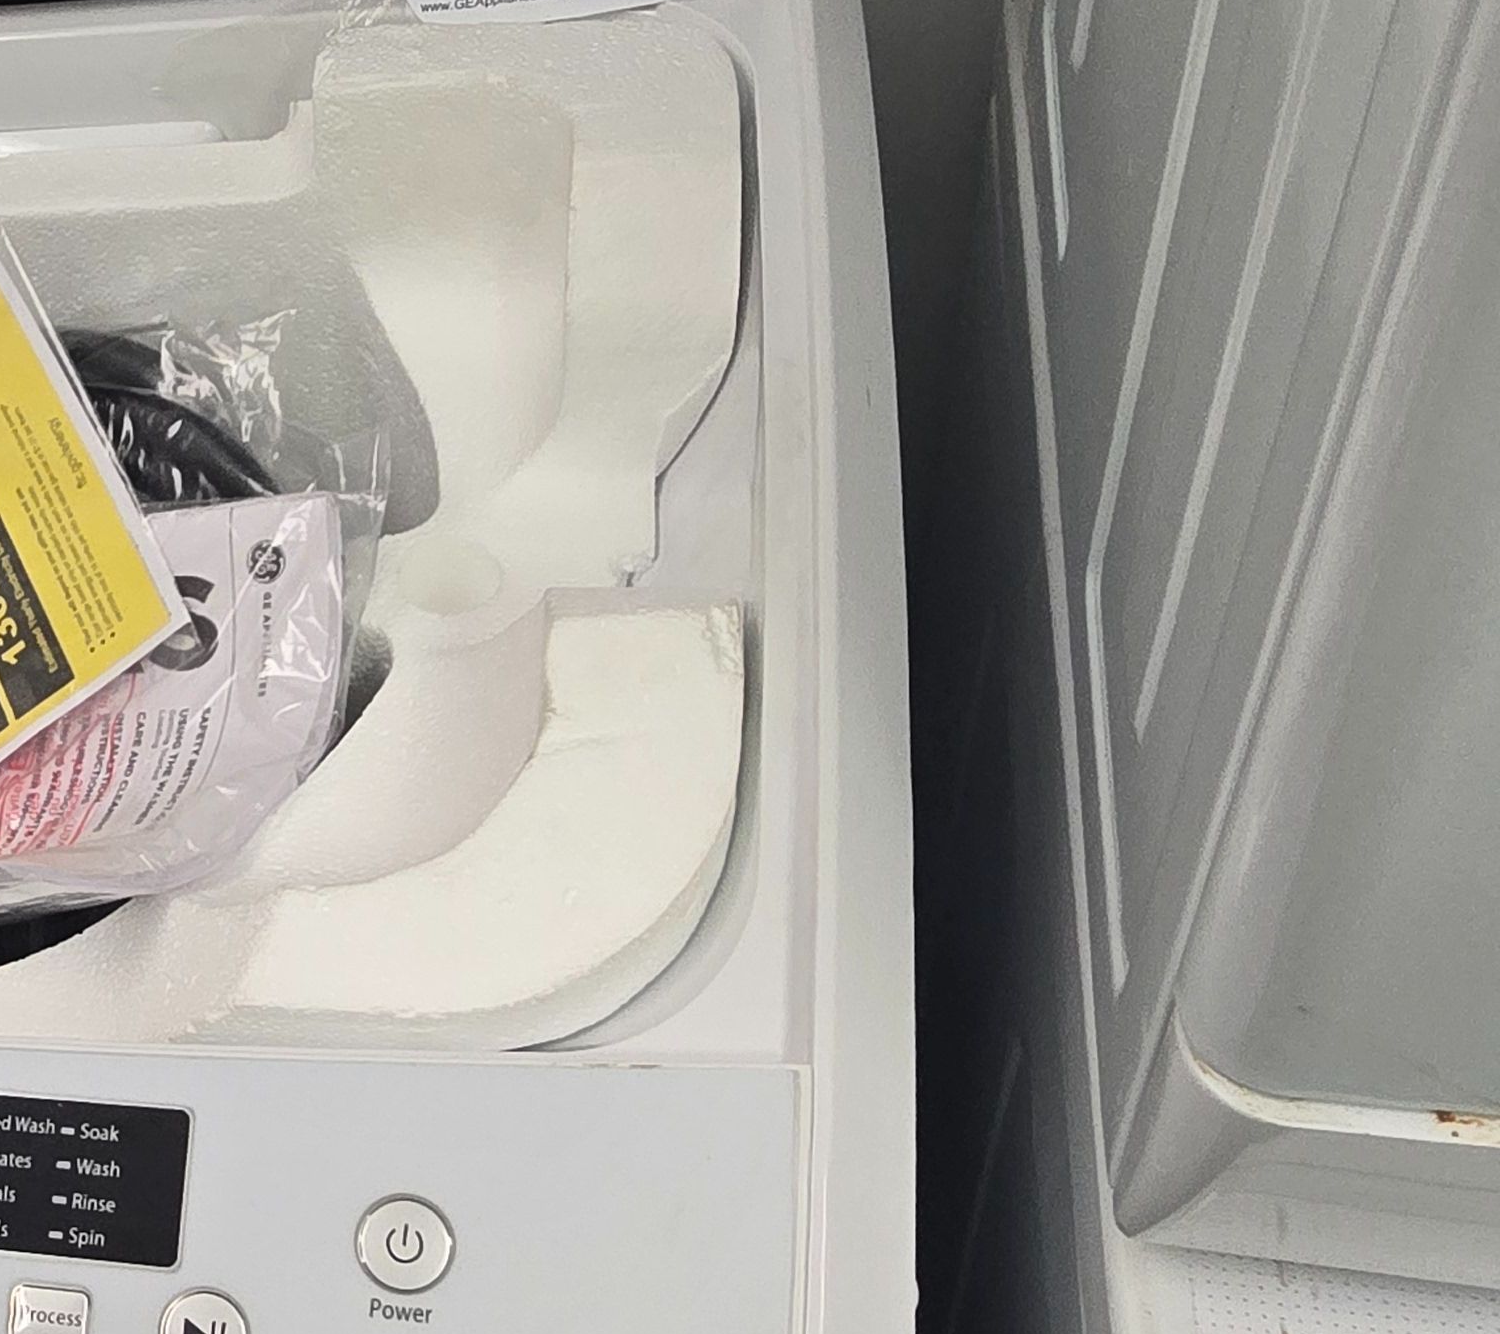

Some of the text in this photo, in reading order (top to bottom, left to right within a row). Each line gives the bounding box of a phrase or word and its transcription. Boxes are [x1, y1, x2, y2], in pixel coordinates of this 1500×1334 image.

[131, 710, 147, 747] CARE
[123, 749, 138, 778] AND
[15, 1116, 56, 1134] Wash
[80, 1124, 120, 1142] Soak
[76, 1160, 121, 1177] Wash
[71, 1193, 116, 1213] Rinse
[68, 1228, 105, 1248] Spin
[368, 1298, 432, 1324] Power
